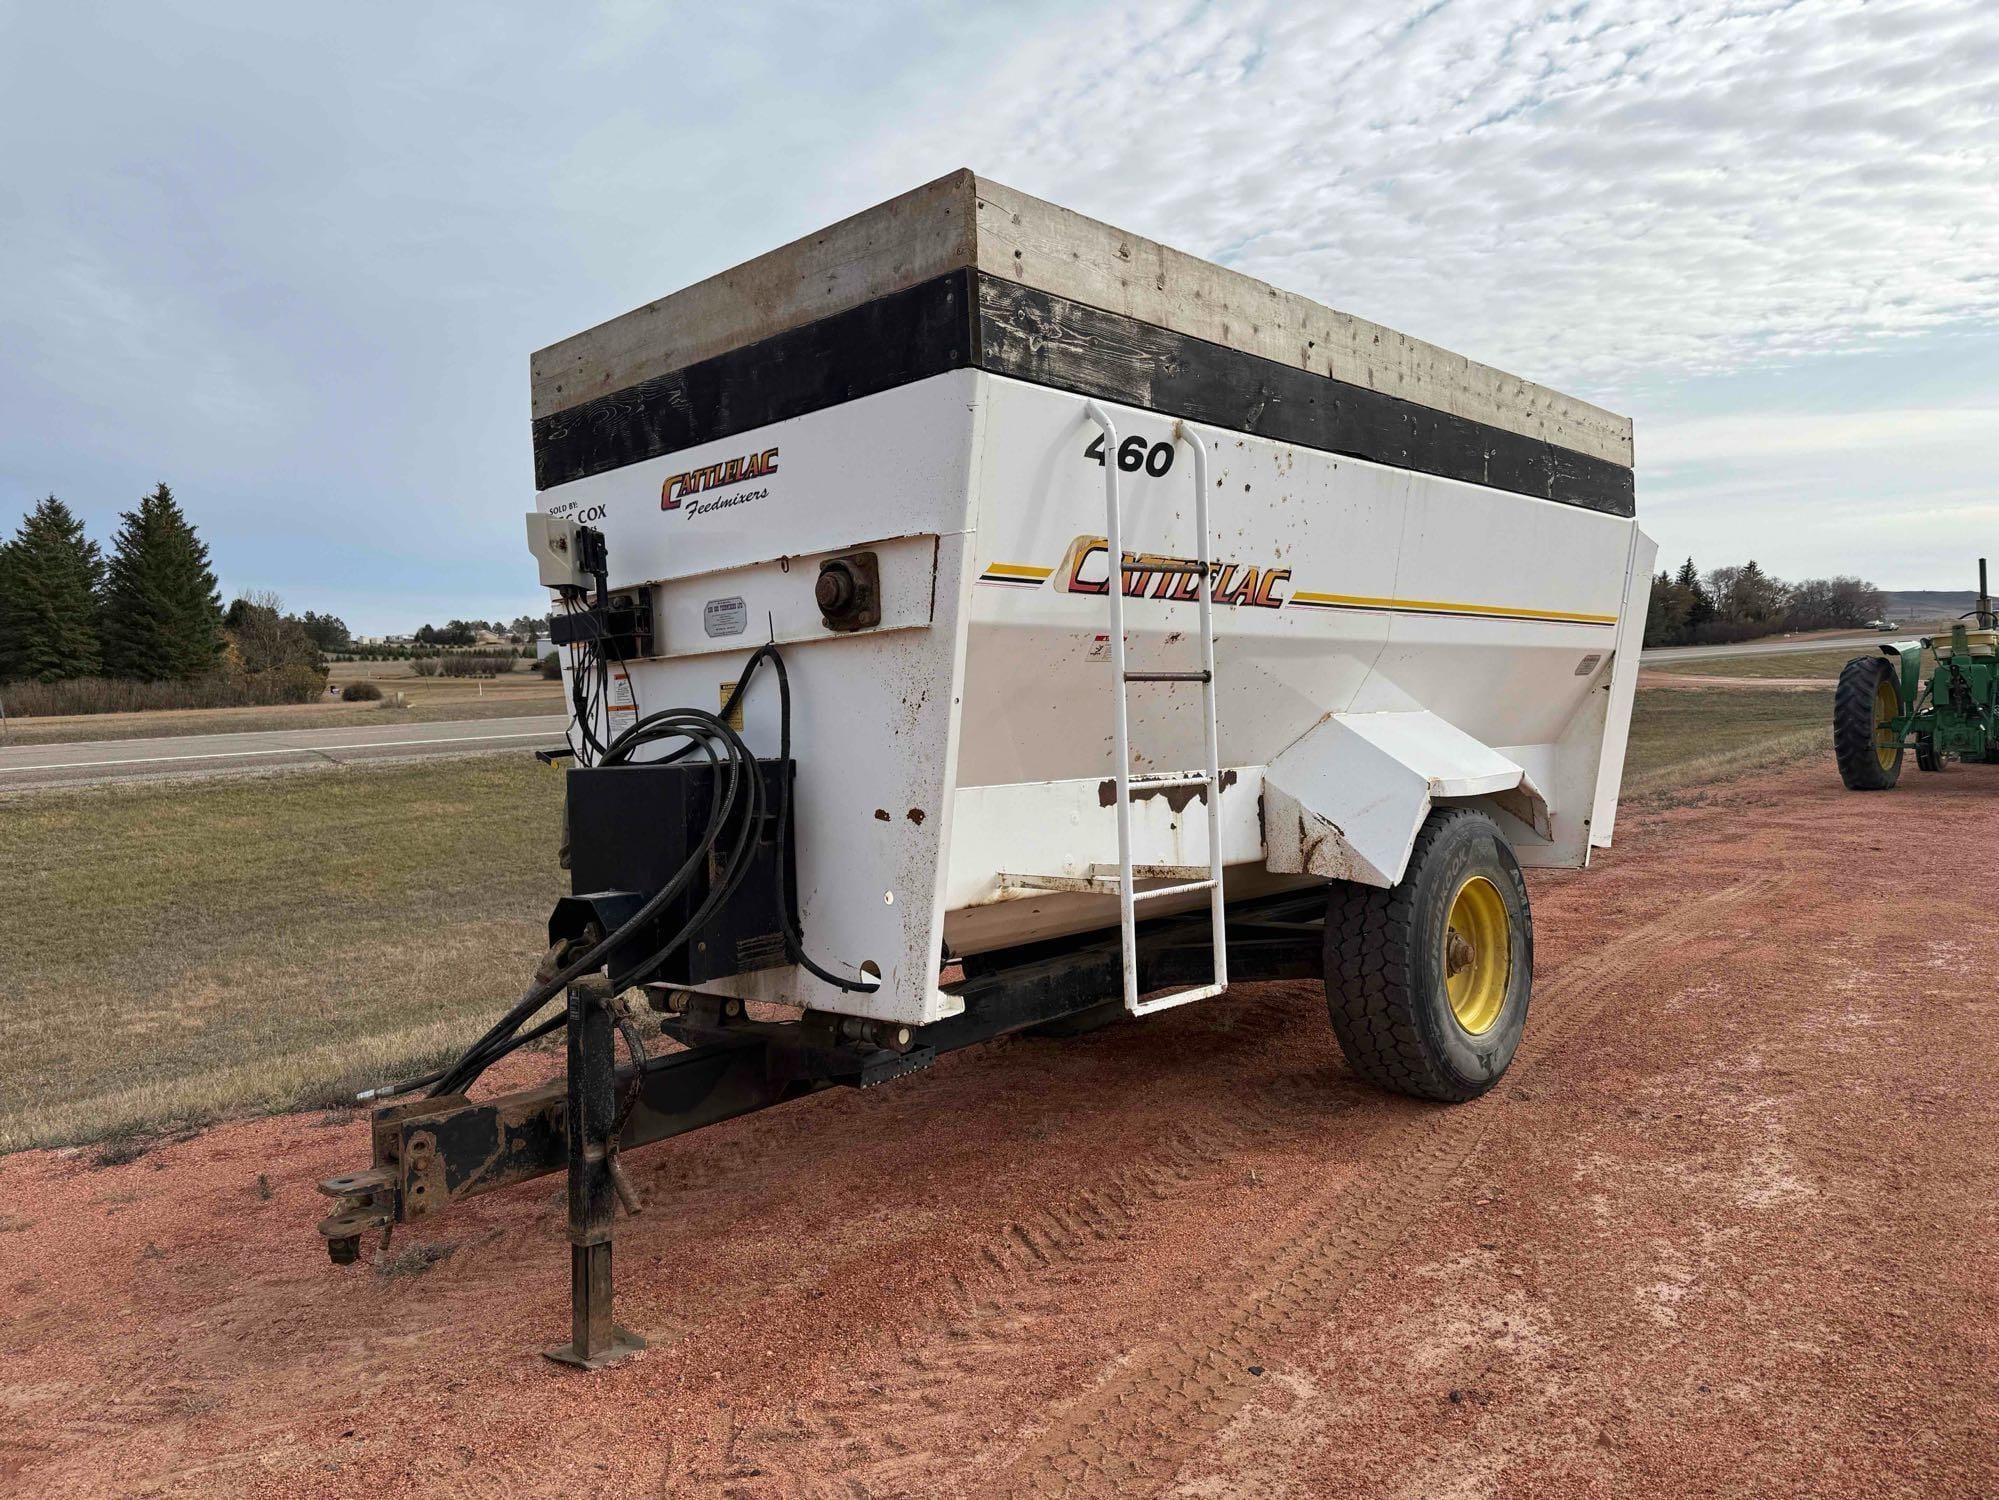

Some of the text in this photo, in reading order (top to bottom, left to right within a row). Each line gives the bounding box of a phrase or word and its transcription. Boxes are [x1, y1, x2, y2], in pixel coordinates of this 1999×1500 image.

[1084, 432, 1175, 478] 460
[661, 447, 779, 512] CATTLELAC
[549, 504, 567, 516] SOLD
[578, 504, 607, 524] COX
[685, 488, 769, 520] Feedmixers
